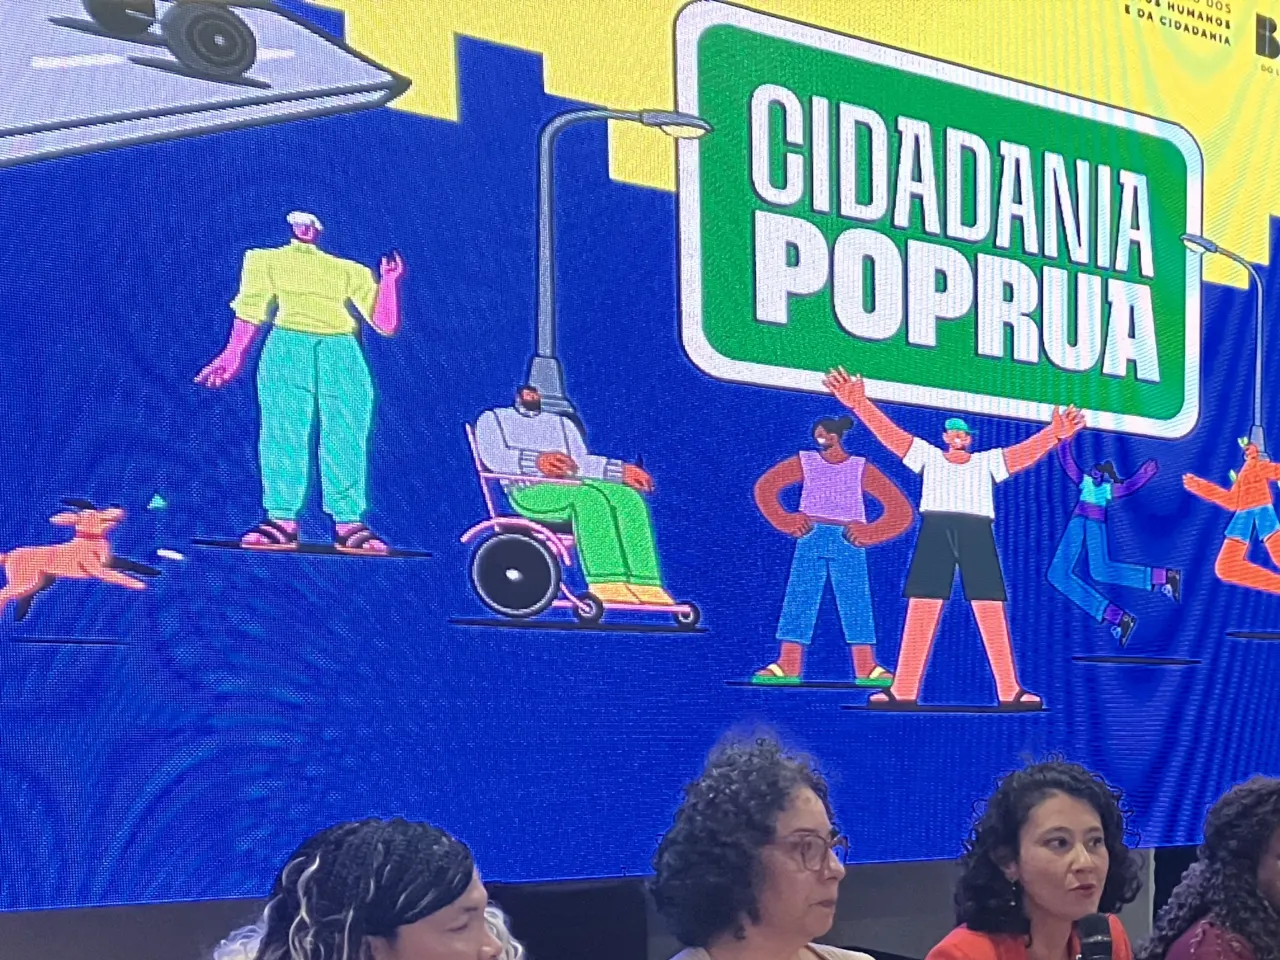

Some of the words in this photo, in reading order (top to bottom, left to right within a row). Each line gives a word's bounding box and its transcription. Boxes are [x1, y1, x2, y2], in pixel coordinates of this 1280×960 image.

[1124, 4, 1131, 15] E
[1137, 8, 1154, 22] DA
[1160, 15, 1232, 46] CIDADANIA
[1167, 1, 1231, 30] HUMANOS
[1260, 63, 1274, 74] DO
[749, 83, 1155, 279] CIDADANIA
[754, 210, 1160, 384] POPRUA
